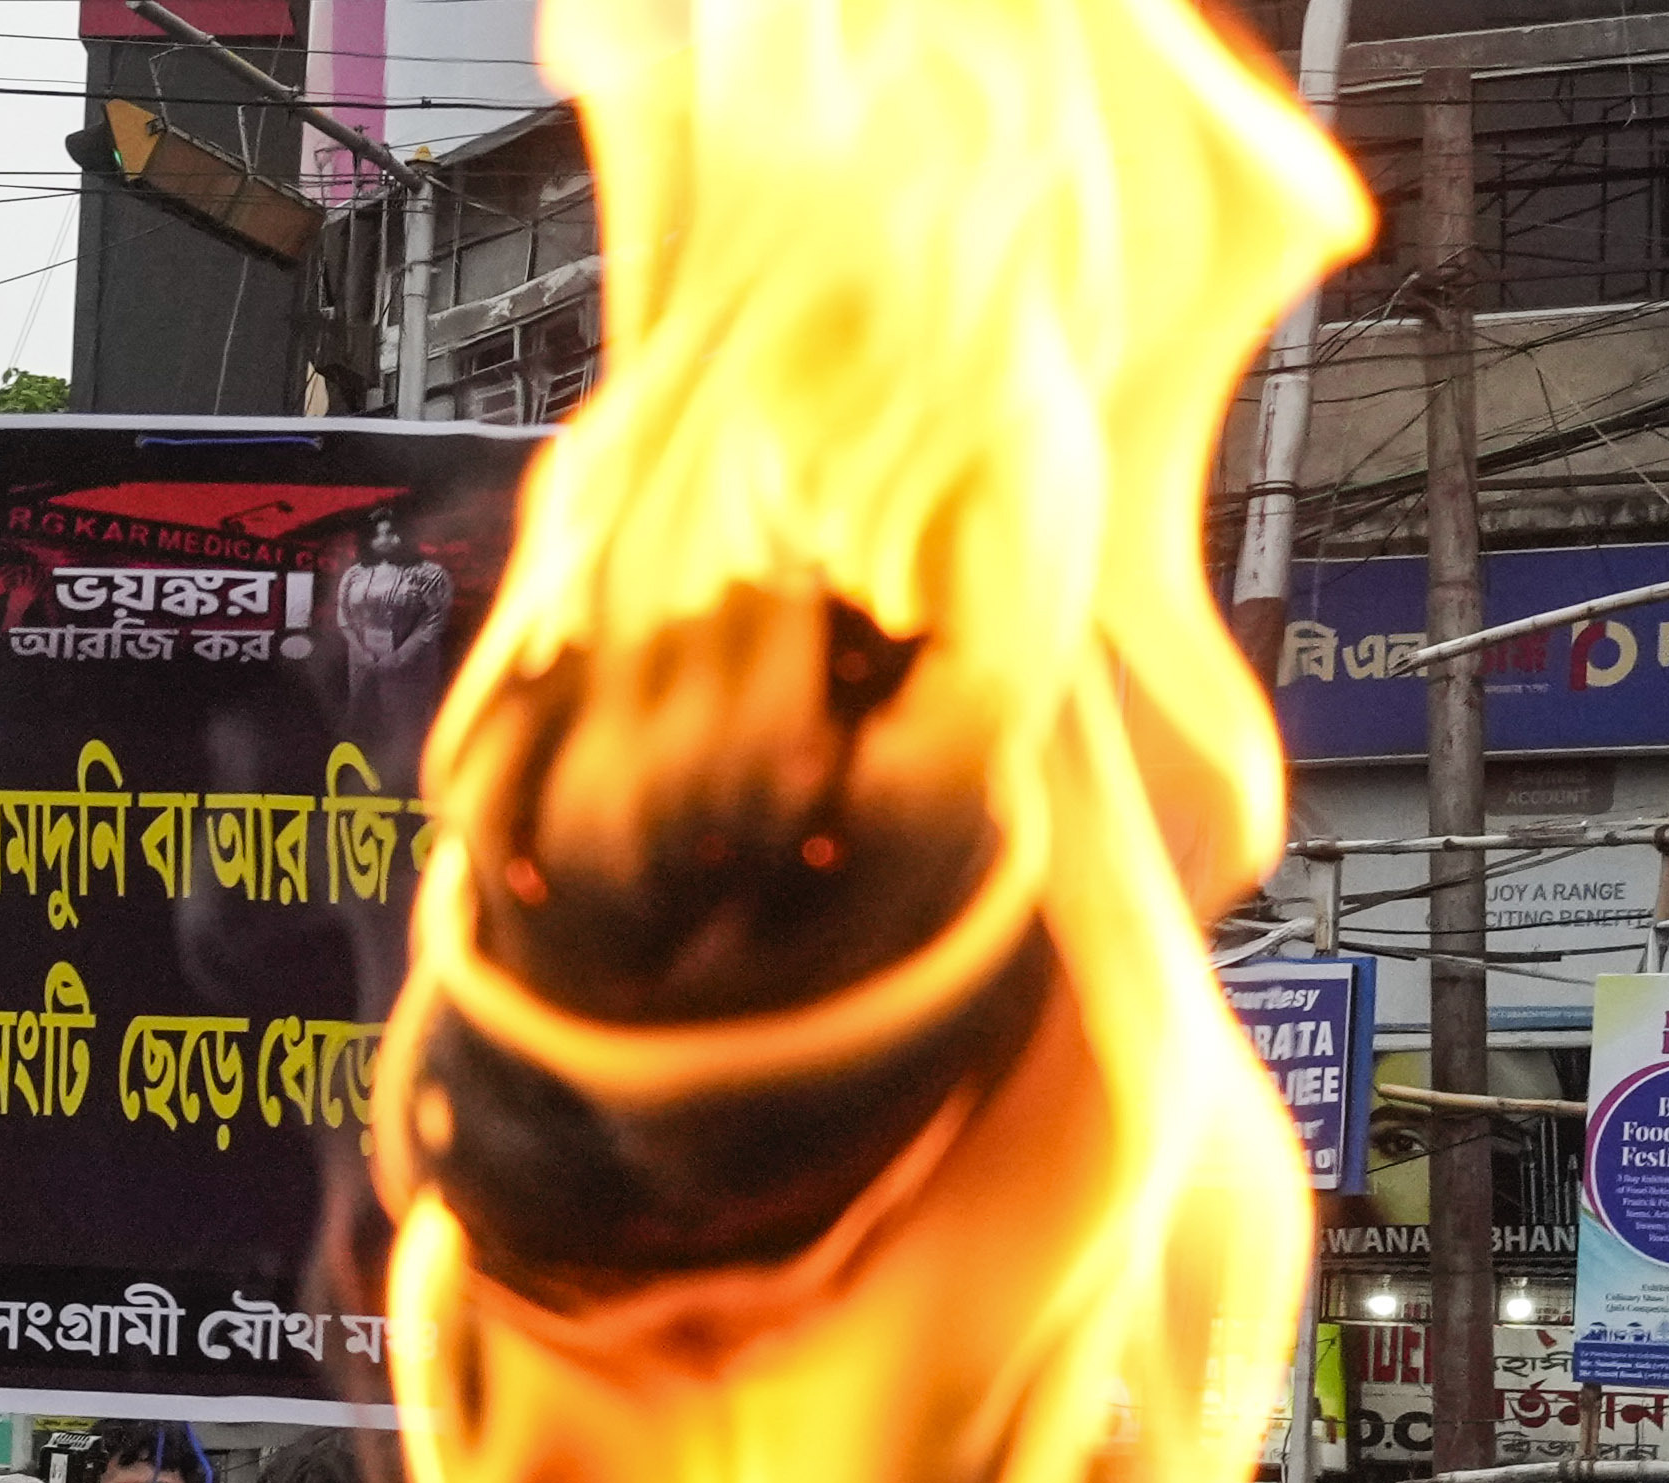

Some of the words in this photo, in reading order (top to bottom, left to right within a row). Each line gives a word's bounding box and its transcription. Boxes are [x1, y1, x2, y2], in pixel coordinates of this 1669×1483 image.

[205, 794, 315, 905] আর
[322, 741, 400, 904] জি
[1533, 884, 1547, 901] A
[1552, 882, 1627, 901] RANGE
[197, 1291, 330, 1364] যৌথ
